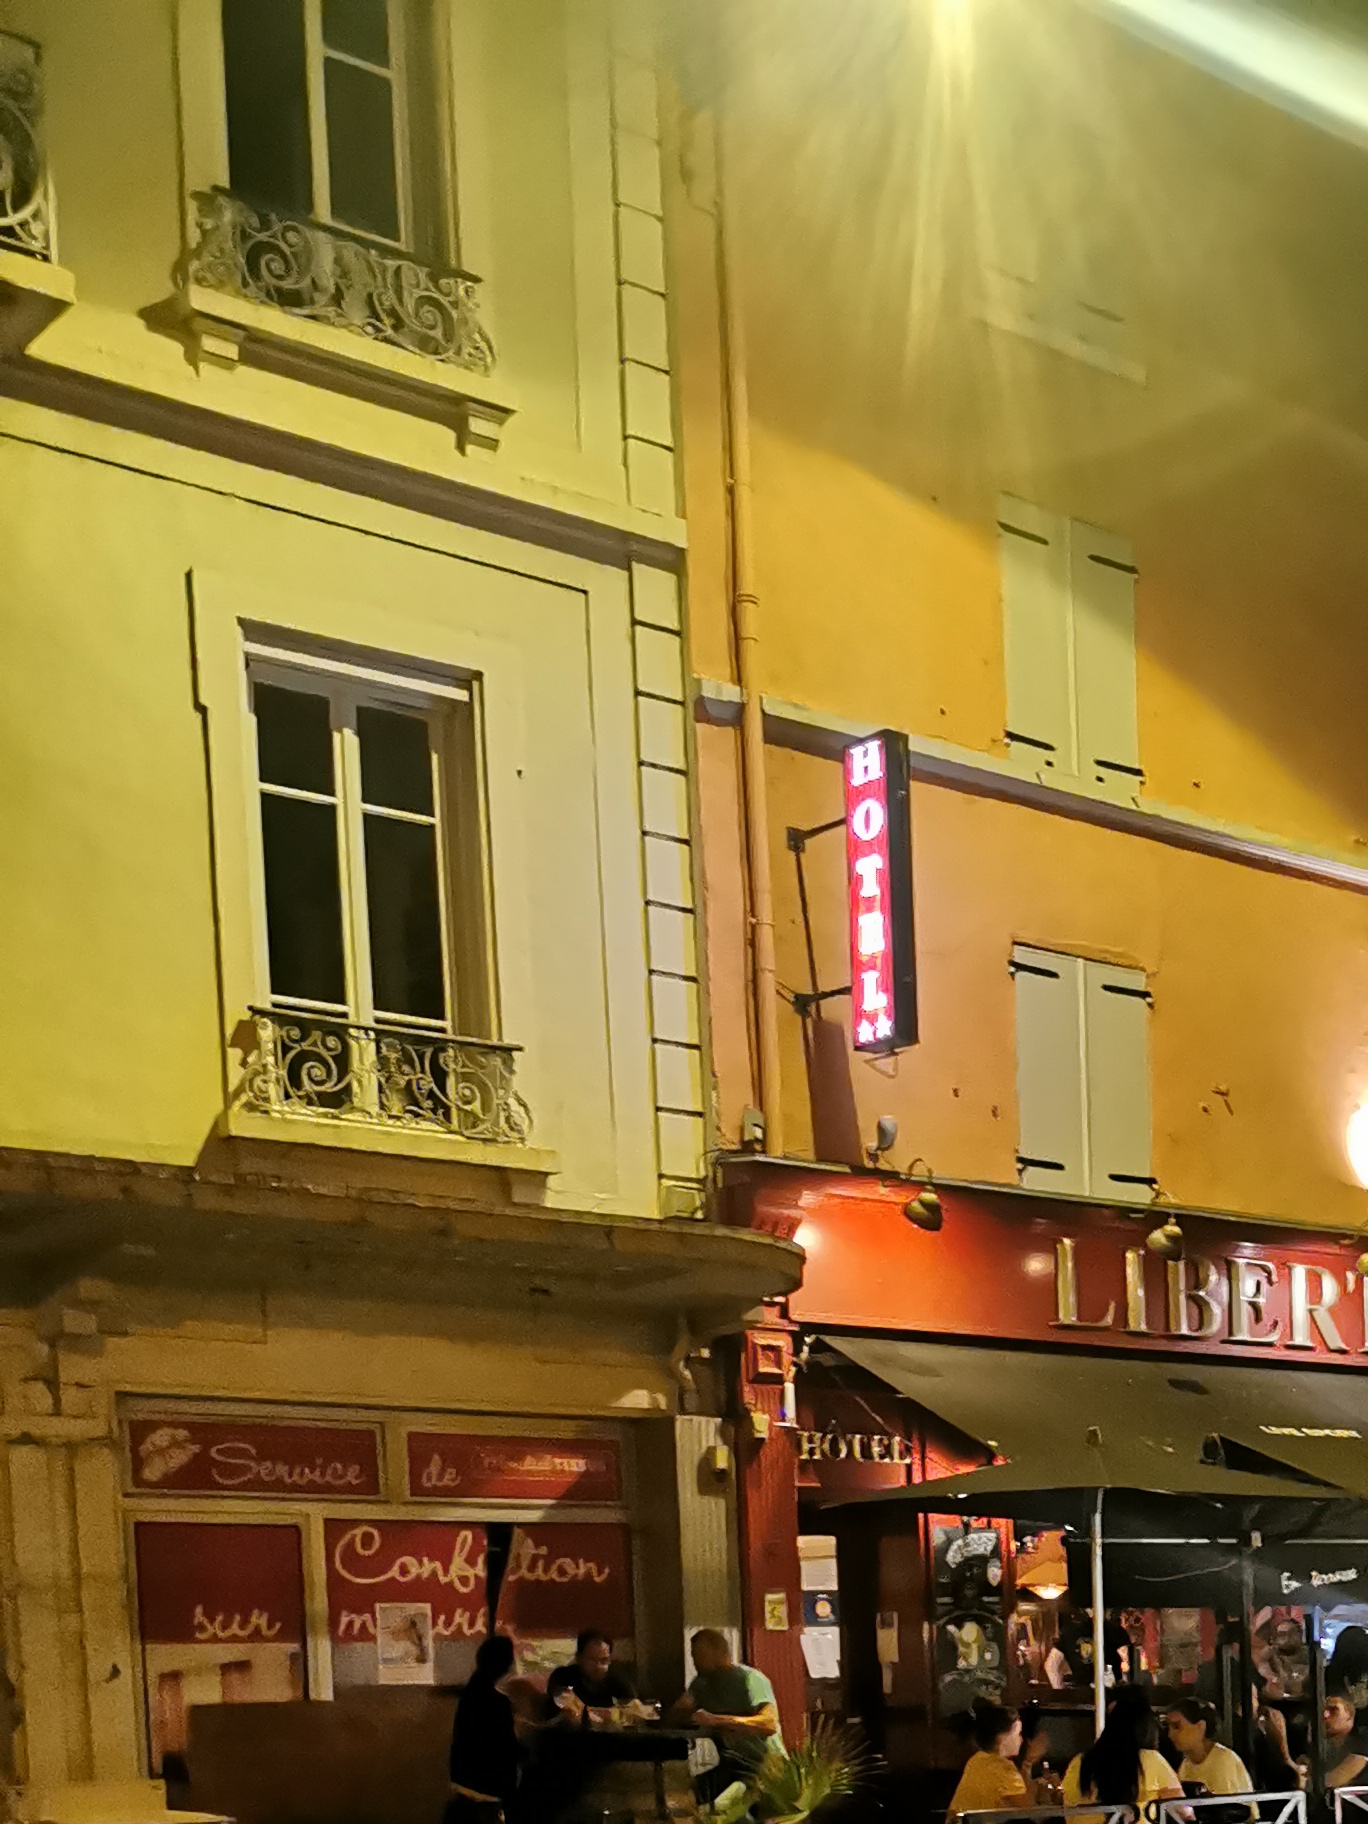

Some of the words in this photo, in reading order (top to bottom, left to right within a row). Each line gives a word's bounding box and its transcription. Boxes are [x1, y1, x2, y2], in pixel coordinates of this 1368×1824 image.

[849, 740, 888, 1012] HOTEL
[210, 1443, 367, 1486] Service
[421, 1453, 462, 1488] de
[335, 1526, 610, 1594] Conftion
[193, 1603, 283, 1640] sur
[338, 1608, 488, 1637] mure
